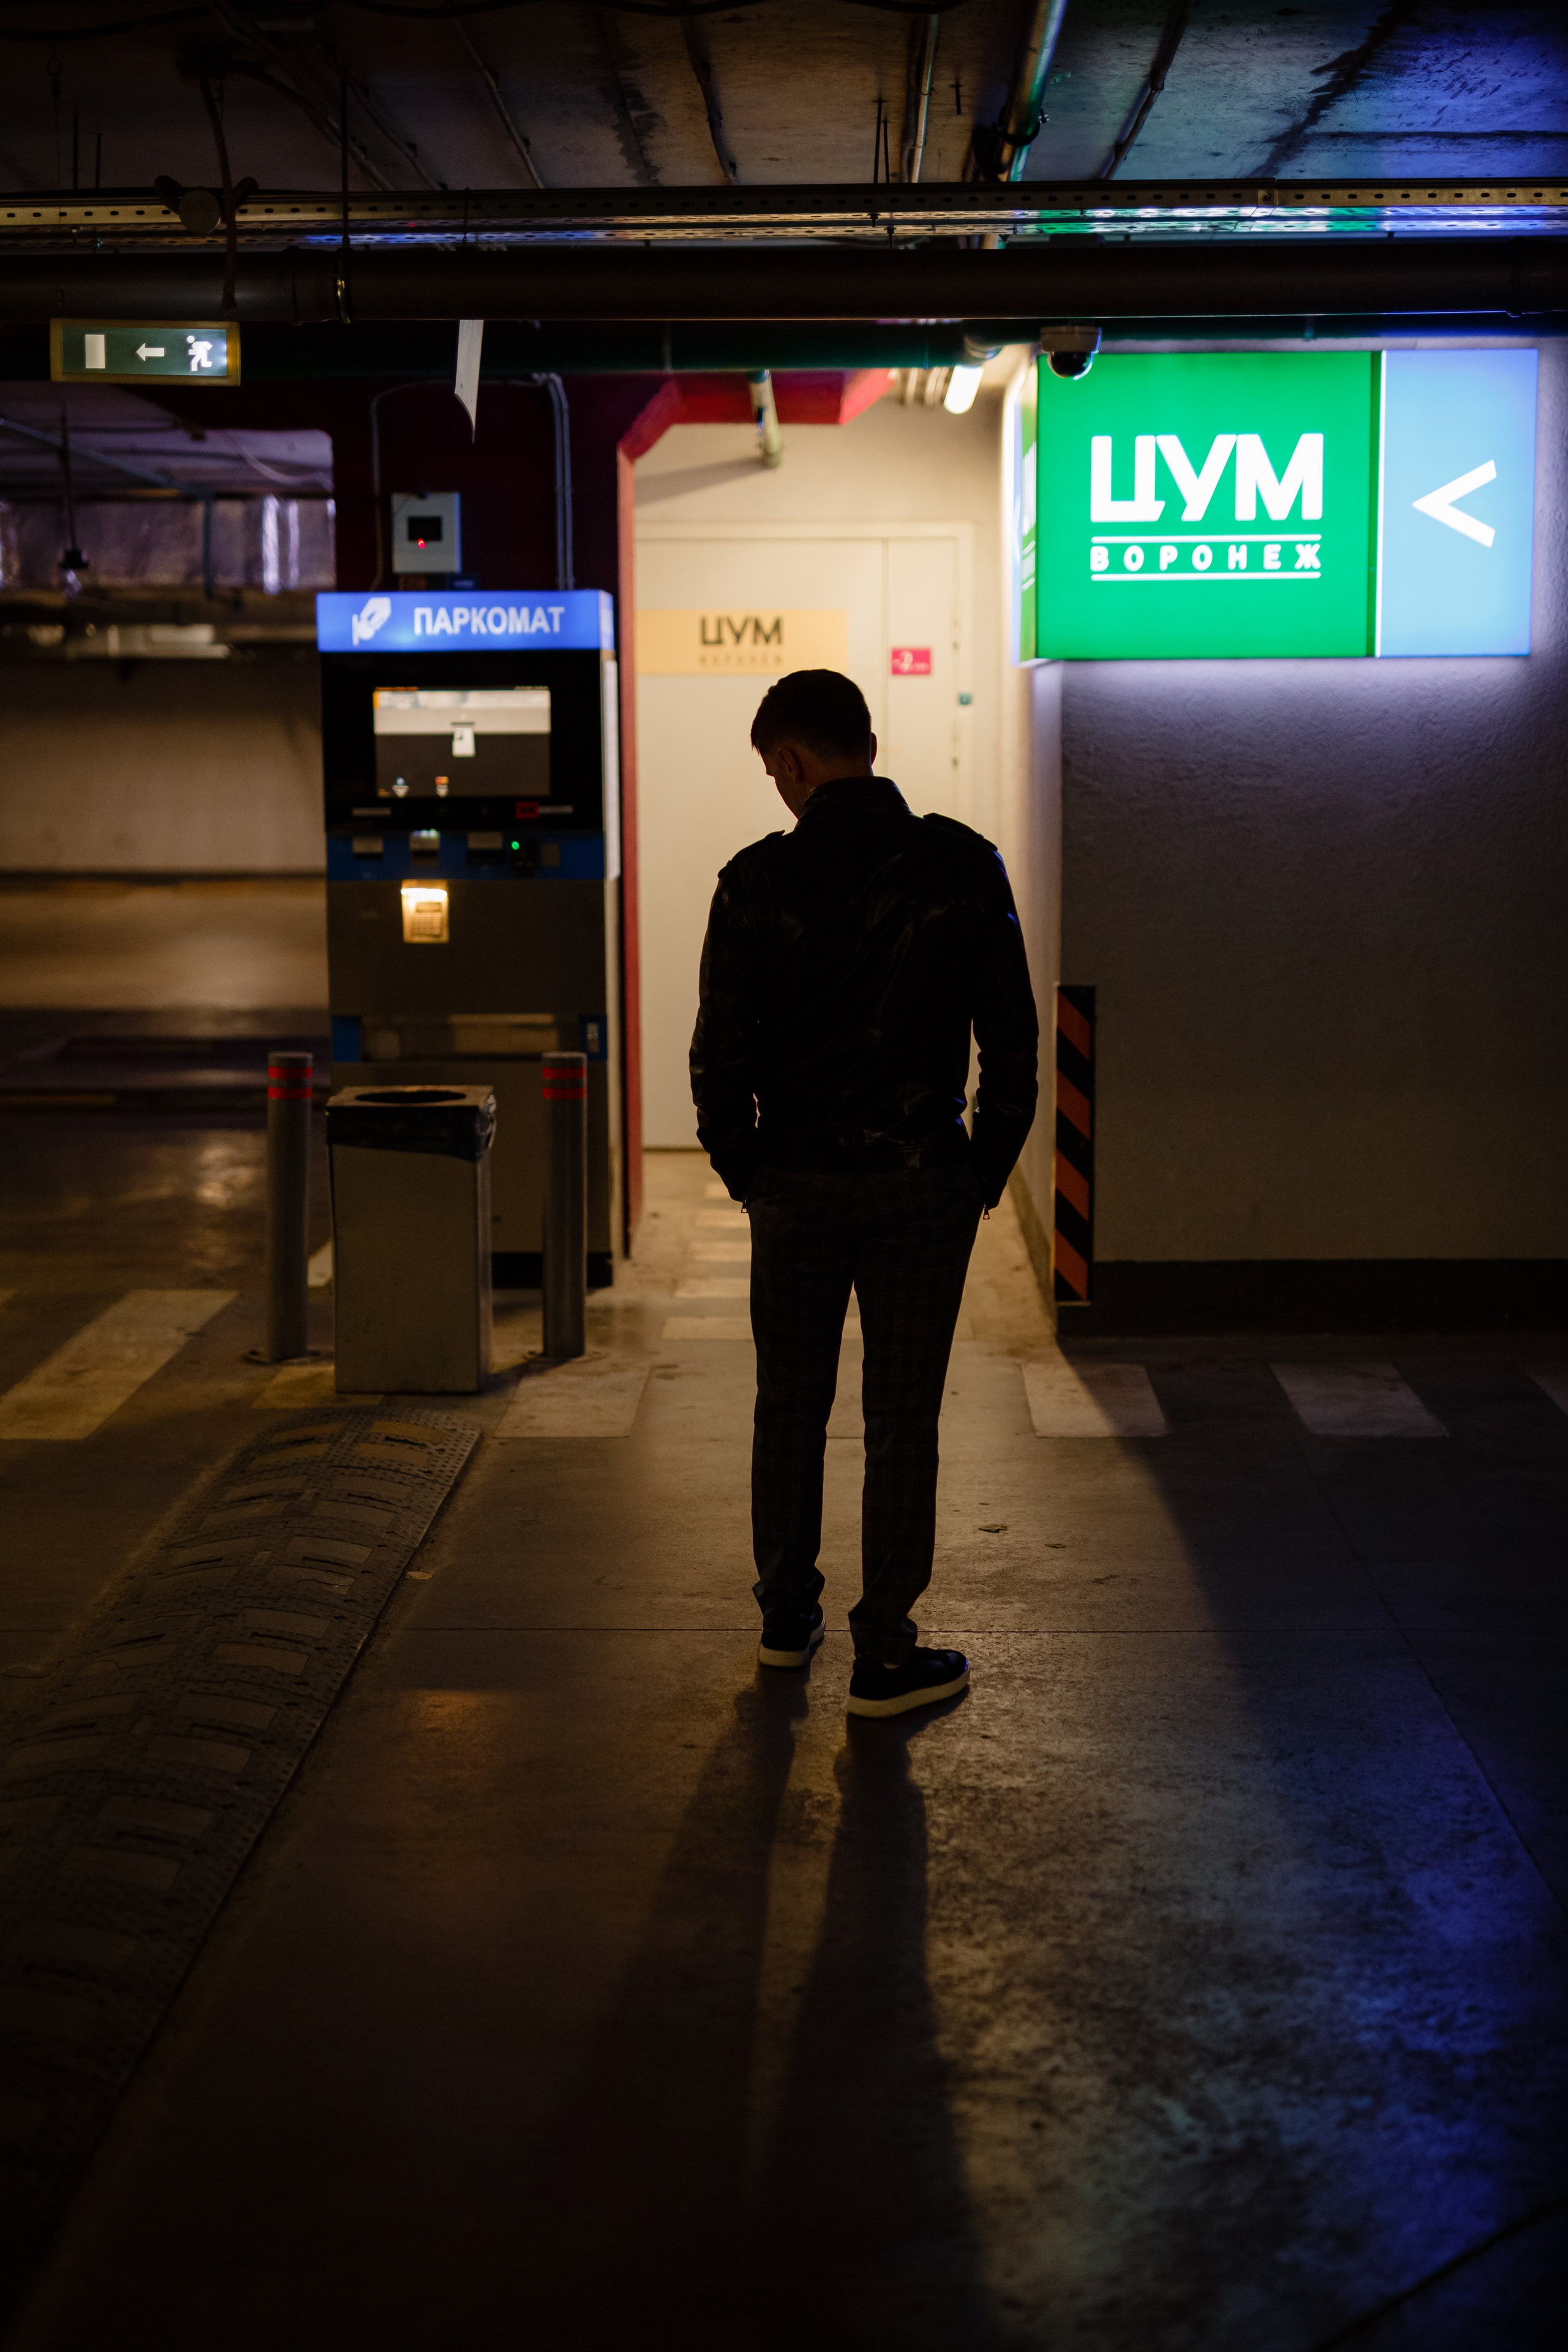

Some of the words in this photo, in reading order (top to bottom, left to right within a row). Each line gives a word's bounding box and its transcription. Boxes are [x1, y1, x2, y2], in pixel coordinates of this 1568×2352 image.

[1090, 432, 1324, 522] ЦУМ
[1090, 543, 1321, 572] ВОРОНЕЖ
[413, 606, 565, 636] ПАРКОМАТ
[701, 615, 782, 646] ЦУМ
